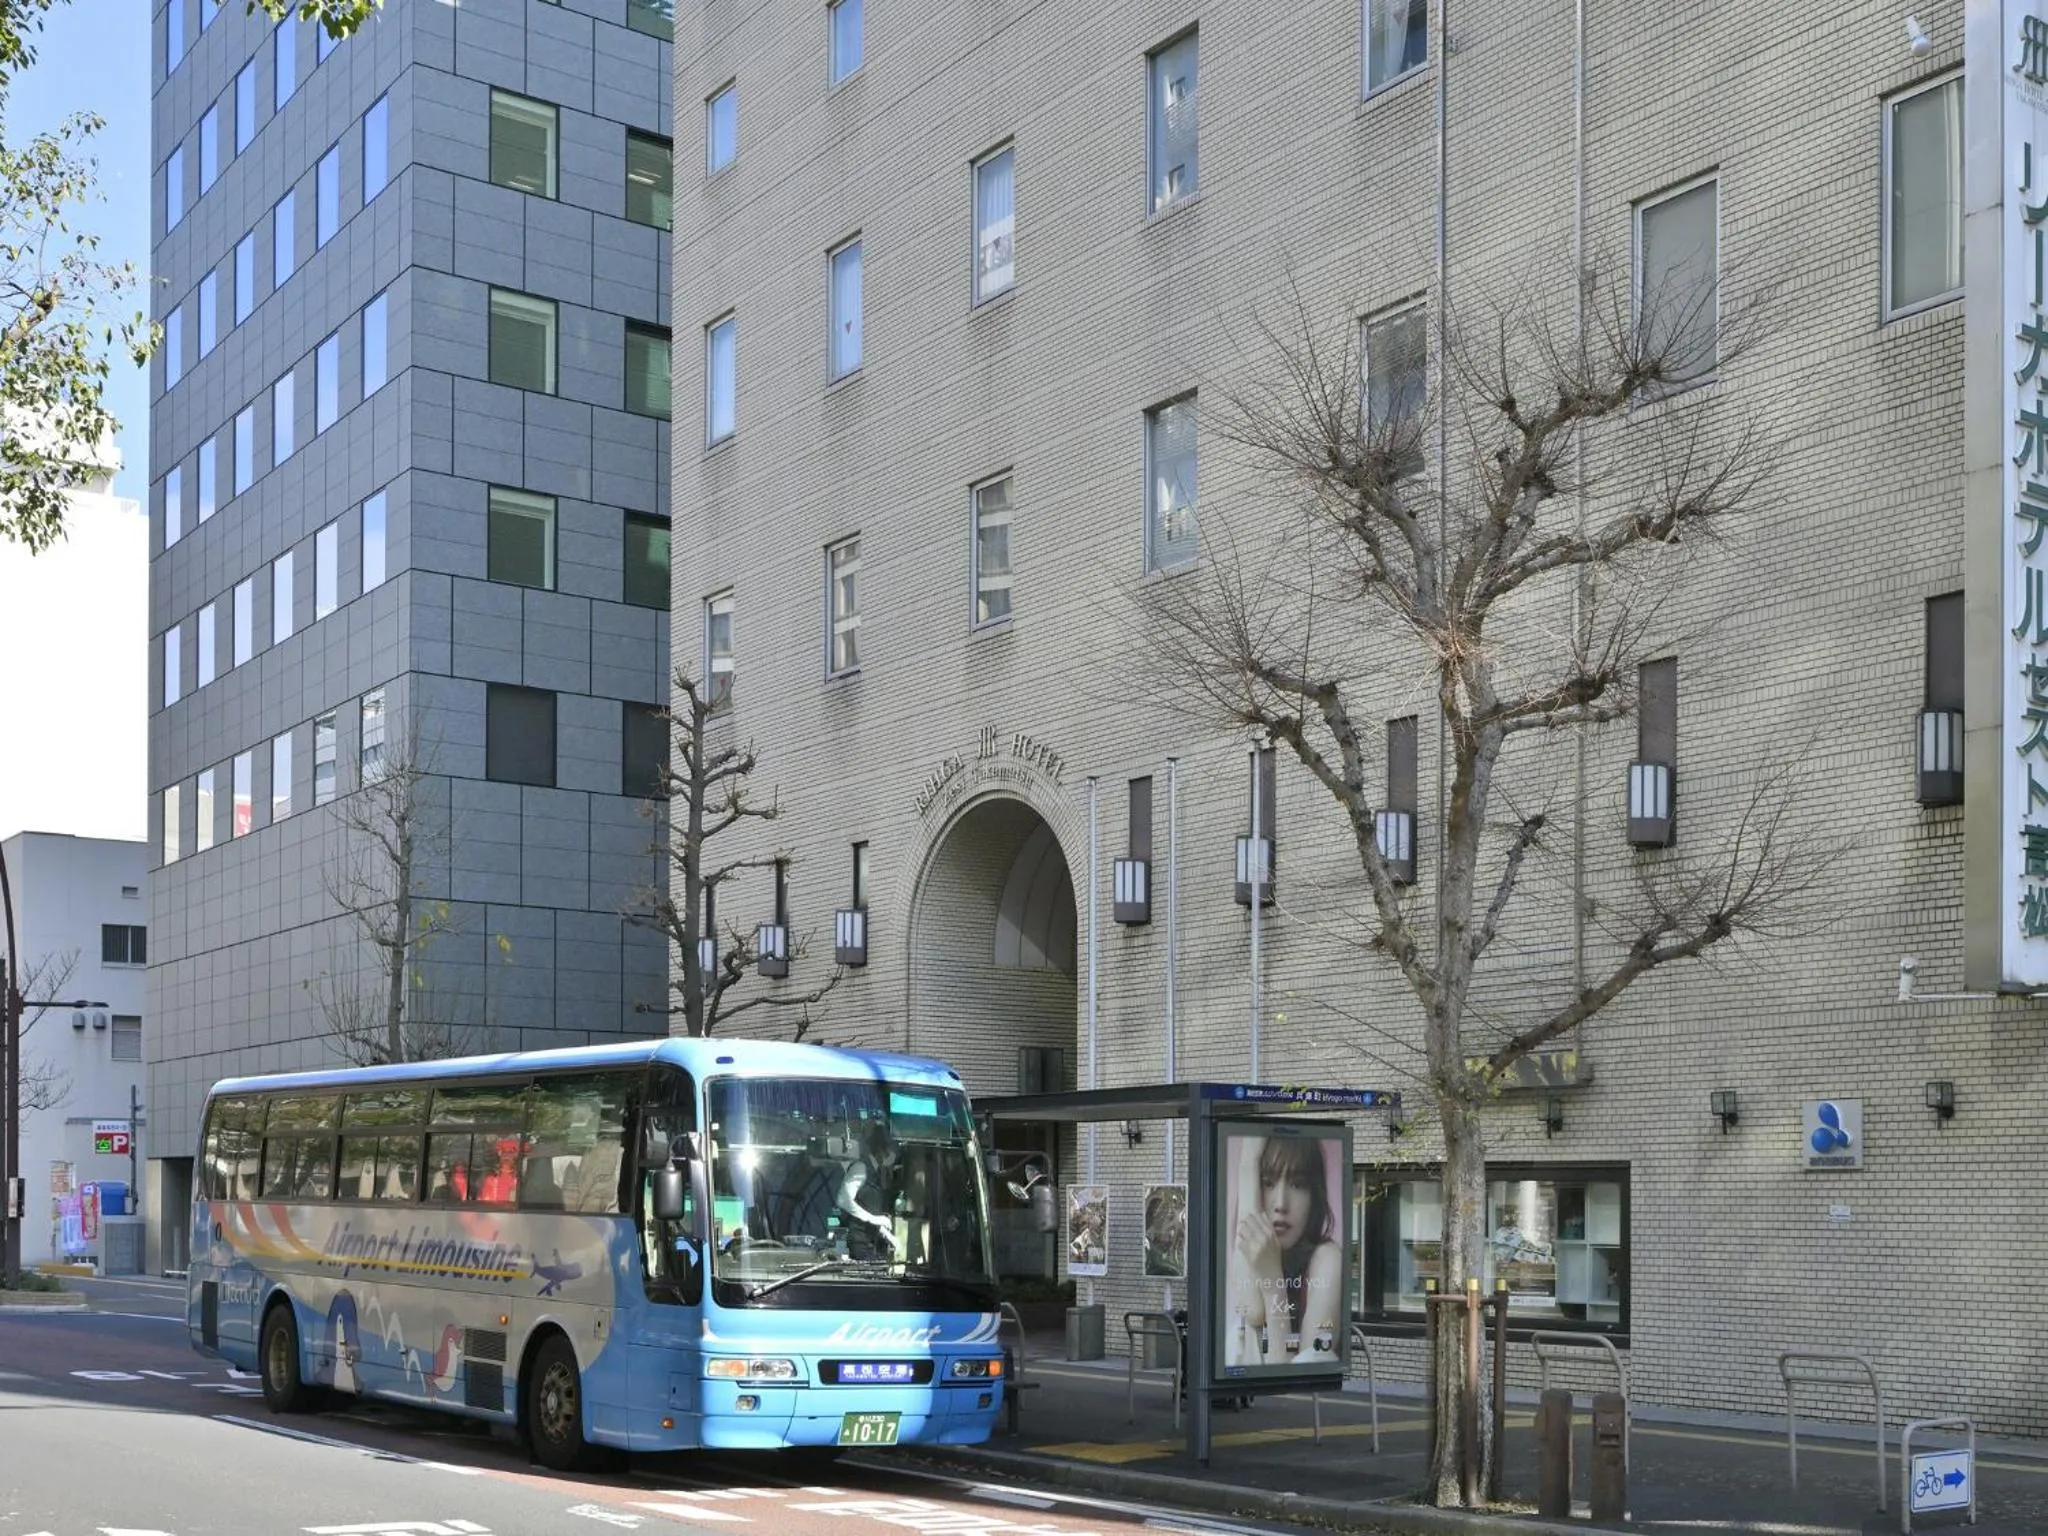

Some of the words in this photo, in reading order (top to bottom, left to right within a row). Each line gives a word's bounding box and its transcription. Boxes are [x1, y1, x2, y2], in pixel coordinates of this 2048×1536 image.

[112, 1134, 128, 1152] P
[317, 1221, 400, 1278] Airport
[397, 1226, 522, 1283] Limousine
[1275, 1274, 1302, 1289] and
[824, 1321, 942, 1349] Airport
